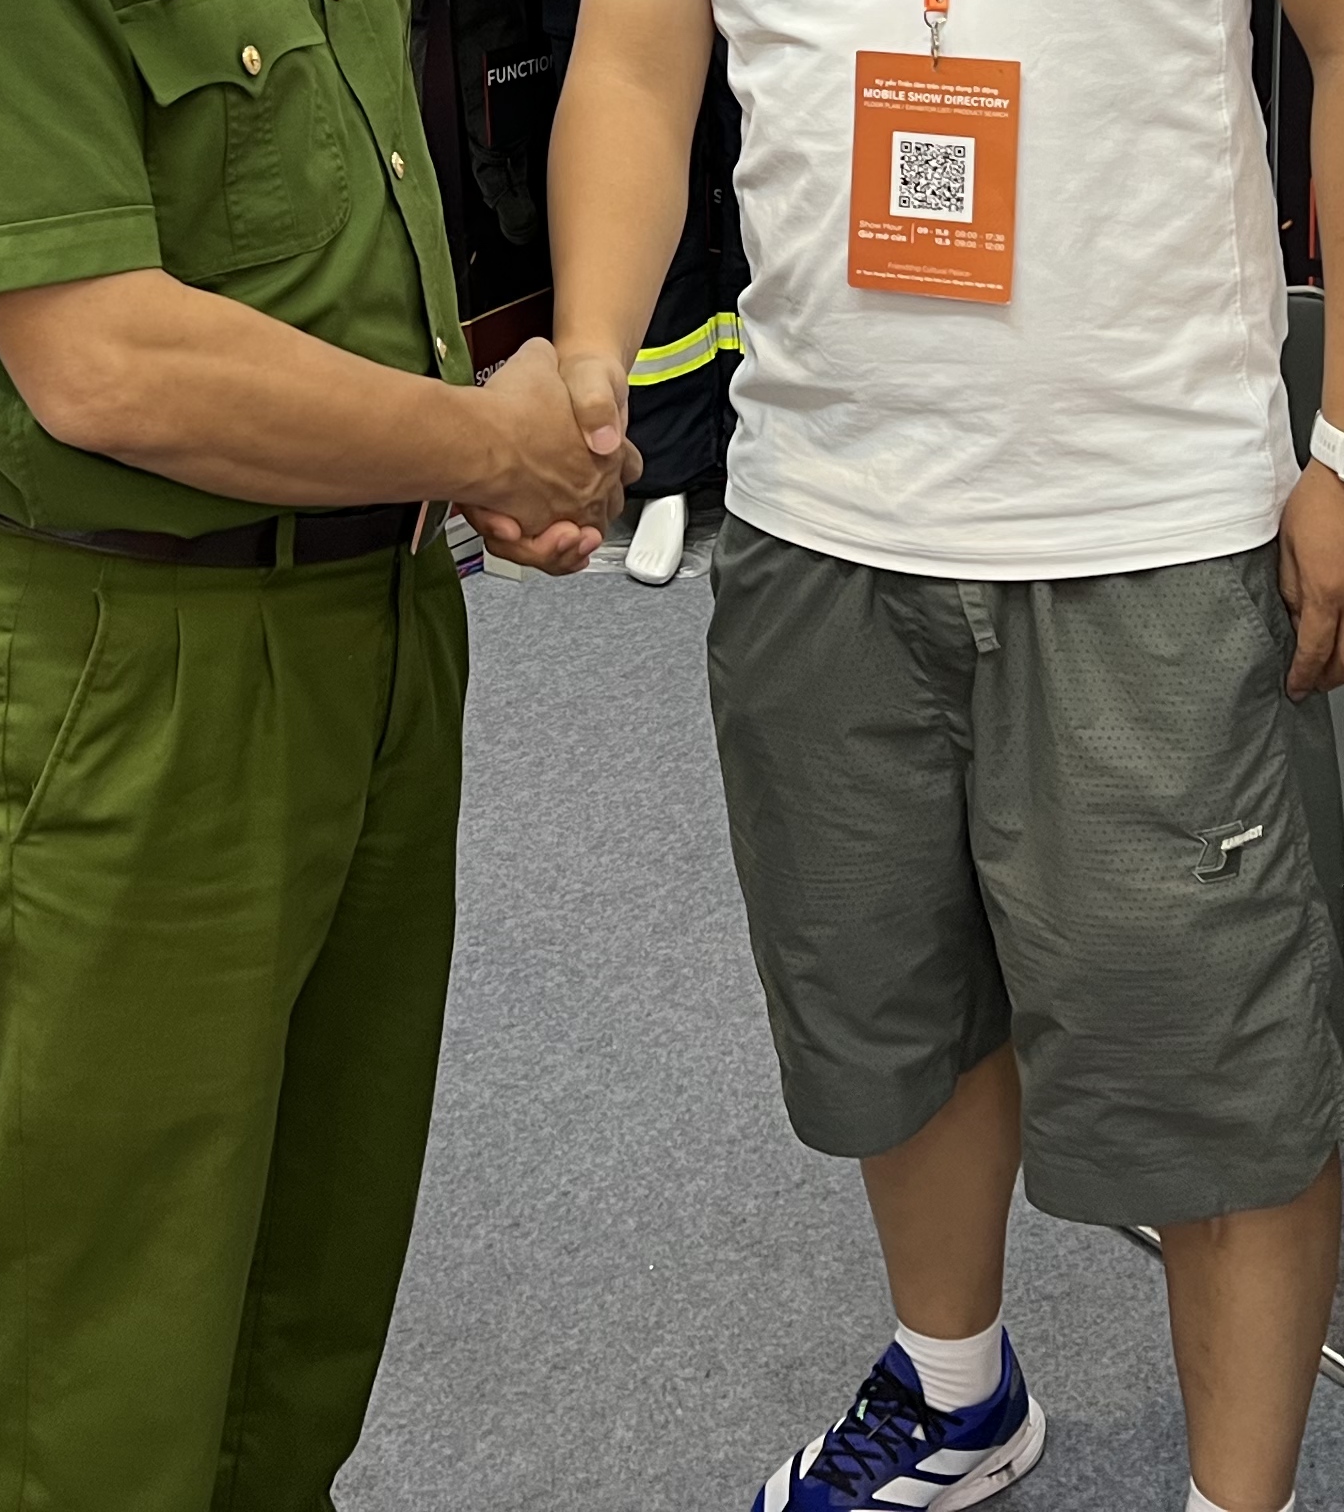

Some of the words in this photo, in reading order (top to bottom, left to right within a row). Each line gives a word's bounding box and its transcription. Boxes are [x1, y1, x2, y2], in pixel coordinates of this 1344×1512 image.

[864, 88, 905, 100] MOBILE
[908, 92, 942, 103] SHOW
[944, 95, 1009, 108] DIRECTORY
